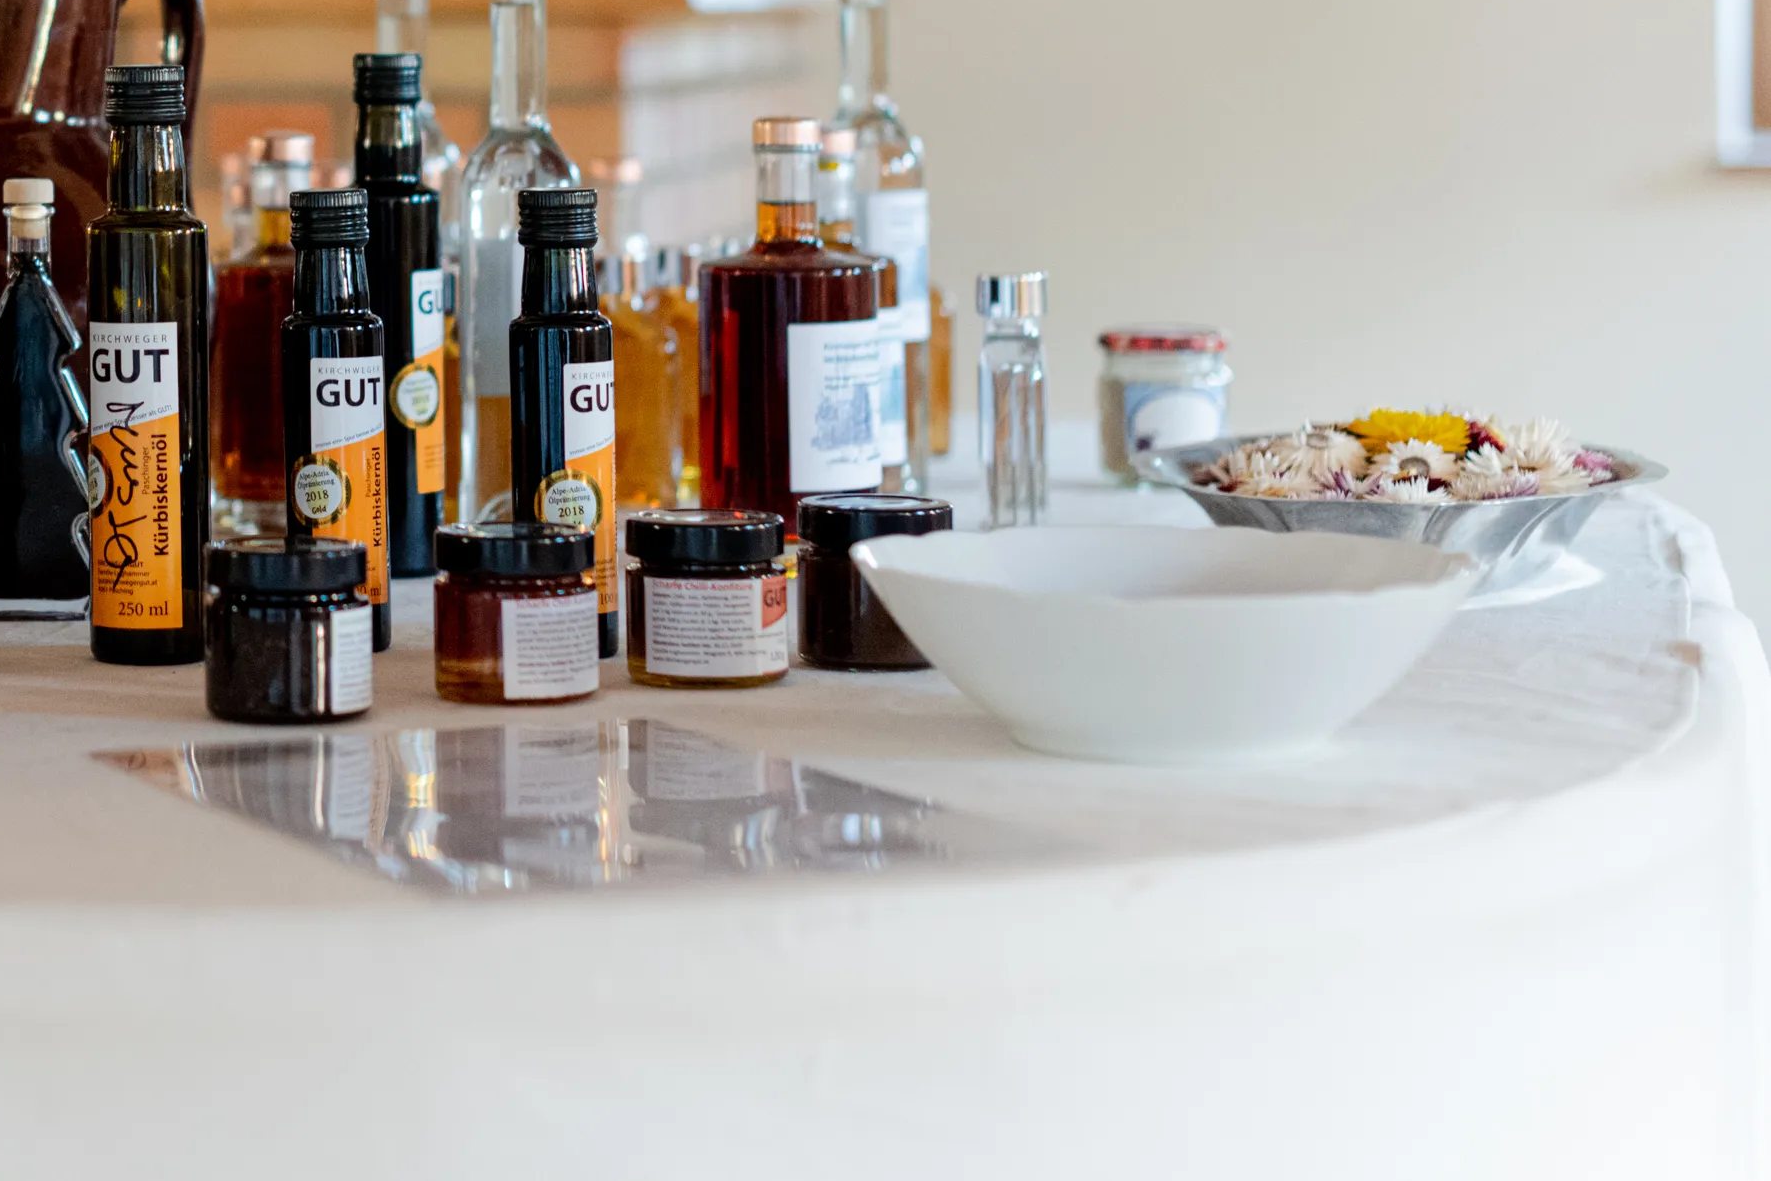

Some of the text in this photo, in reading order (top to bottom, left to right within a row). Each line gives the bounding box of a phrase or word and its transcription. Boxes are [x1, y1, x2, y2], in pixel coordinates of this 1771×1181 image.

[418, 290, 444, 315] GU
[92, 334, 168, 344] KIRCHWEGER
[92, 348, 169, 384] GUT
[318, 365, 380, 374] KIRCHWEGER
[316, 377, 381, 407] GUT
[142, 446, 152, 495] Paschinger
[299, 471, 330, 480] Alpe-Adria
[151, 433, 169, 556] Kürbiskernöl
[305, 489, 329, 502] 2018
[372, 447, 382, 547] Kürbiskernöl
[551, 485, 587, 496] Alpe-Adria
[311, 505, 327, 514] Gold
[558, 505, 585, 518] 2018
[118, 600, 169, 616] 250 ml
